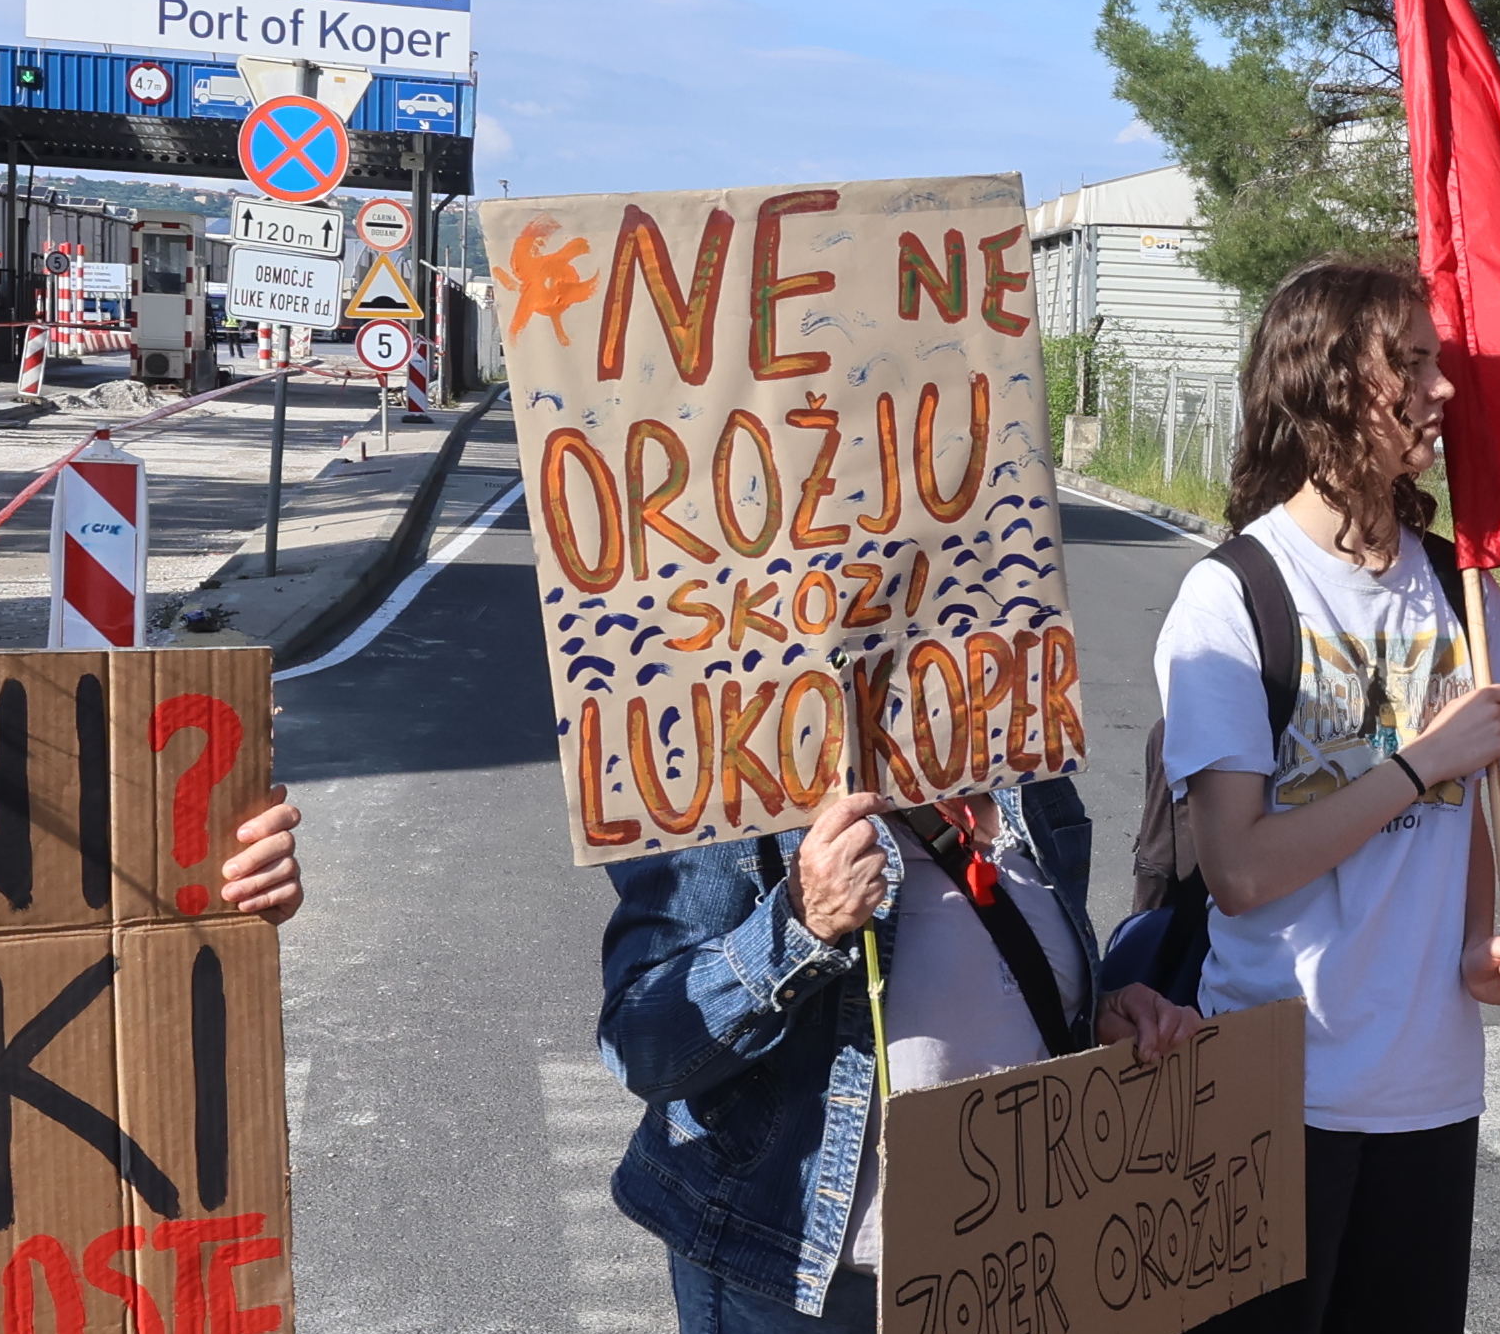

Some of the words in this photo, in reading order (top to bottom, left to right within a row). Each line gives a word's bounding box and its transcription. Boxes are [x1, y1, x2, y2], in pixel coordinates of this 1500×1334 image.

[261, 8, 304, 46] of
[320, 10, 450, 63] Koper
[371, 229, 397, 238] DOUANE
[372, 214, 397, 222] CARINA
[54, 258, 61, 269] 5
[256, 265, 315, 289] OBMOČJE
[597, 188, 841, 386] NE
[897, 224, 1032, 338] NE
[234, 288, 264, 308] LUKE
[270, 293, 310, 314] KOPER
[377, 333, 392, 359] 5
[541, 372, 990, 594] OROŽJU
[662, 550, 930, 652] SKOZI
[579, 668, 847, 848] LUKO
[852, 625, 1088, 804] KOPER
[954, 1025, 1219, 1237] STROŽJE
[1094, 1130, 1272, 1311] OROŽJE!
